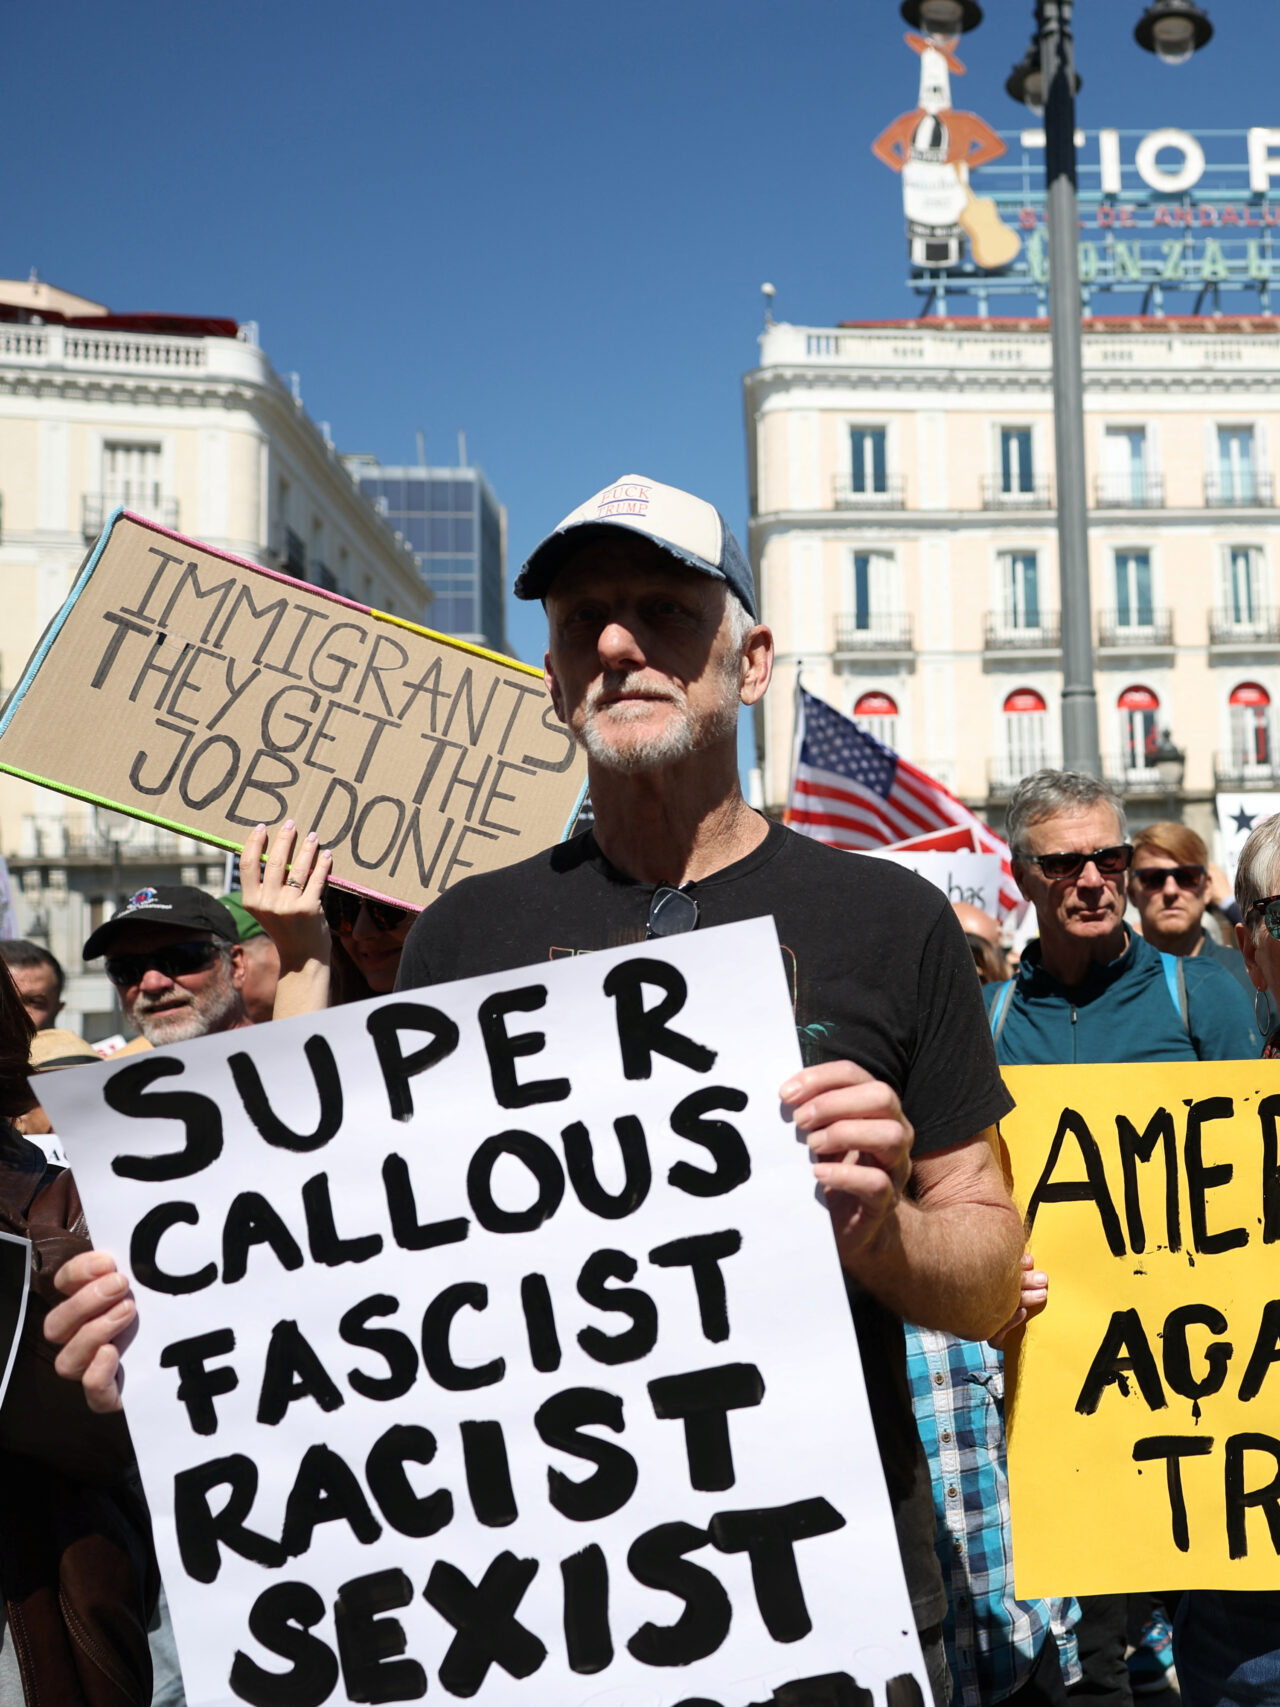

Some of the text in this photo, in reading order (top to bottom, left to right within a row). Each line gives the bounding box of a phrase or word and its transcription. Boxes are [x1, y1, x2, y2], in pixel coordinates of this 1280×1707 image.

[1096, 204, 1138, 227] DE
[596, 503, 649, 517] TRUMP
[600, 485, 649, 504] FUCK
[90, 610, 540, 837] THEY GET THE
[119, 546, 577, 773] IMMIGRANTS
[128, 716, 501, 895] JOB DONE
[102, 957, 718, 1183] SUPER
[129, 1085, 752, 1295] CALLOUS
[160, 1228, 743, 1436] FASCIST
[174, 1362, 765, 1583] RACIST
[229, 1495, 847, 1707] SEXIST
